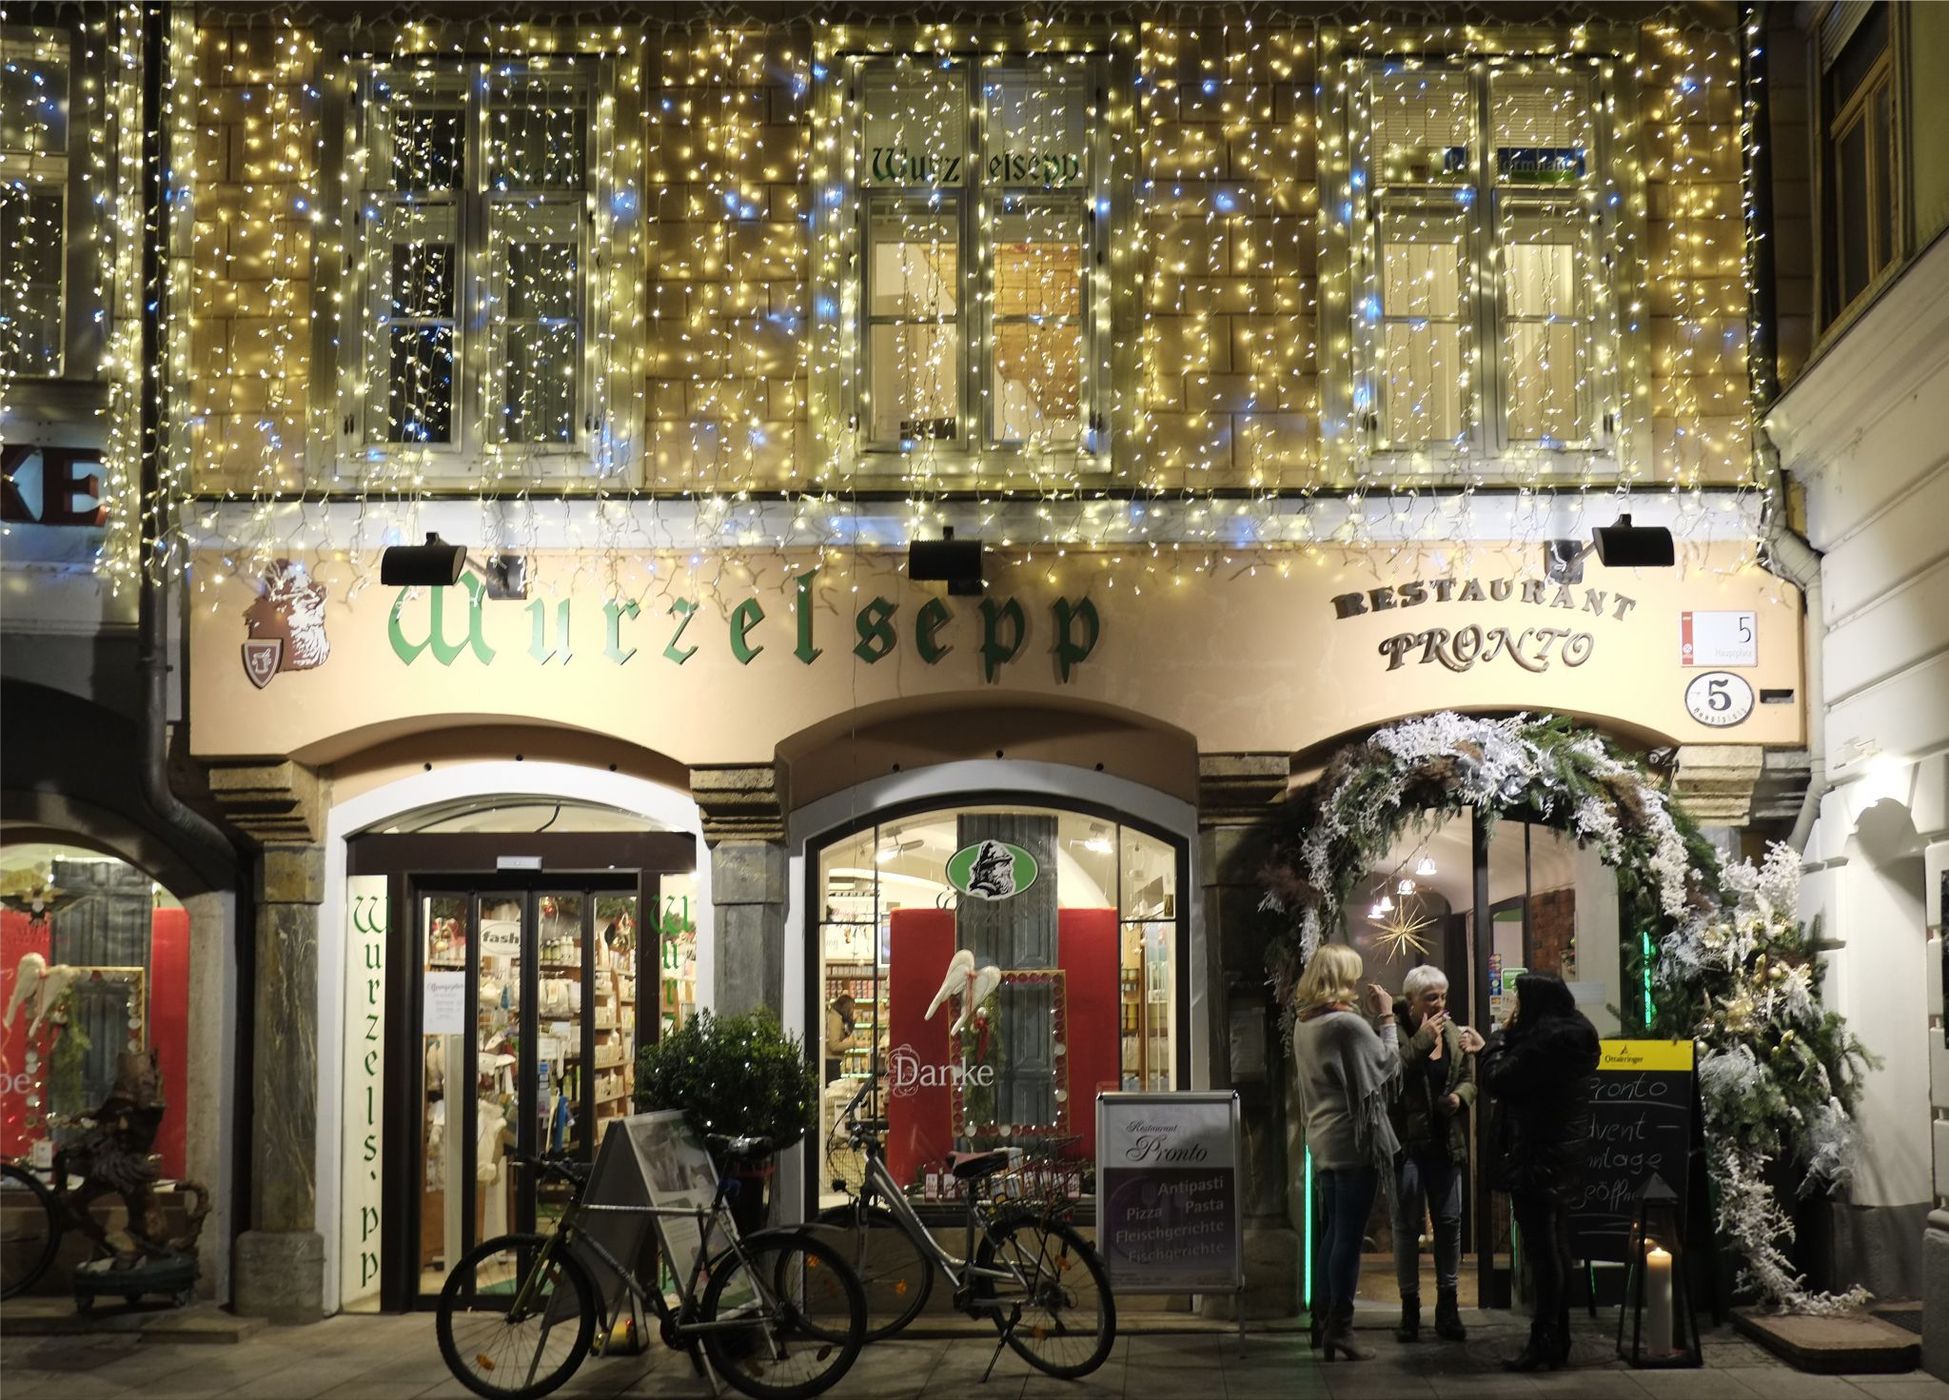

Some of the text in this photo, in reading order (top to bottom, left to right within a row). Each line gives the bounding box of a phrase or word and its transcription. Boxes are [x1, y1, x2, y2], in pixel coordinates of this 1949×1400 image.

[1331, 577, 1636, 621] RESTAURANT
[388, 570, 1099, 684] Wurzelsepp
[1738, 616, 1752, 643] 5
[1378, 623, 1594, 673] PRONTO
[1708, 679, 1732, 711] 5
[482, 931, 519, 943] fash
[893, 1055, 994, 1087] Danke
[1126, 1120, 1179, 1132] Restaurant
[1125, 1135, 1209, 1163] Pronto
[1157, 1176, 1224, 1196] Antipasti
[1126, 1198, 1224, 1221] Pizza Pasta
[1115, 1220, 1224, 1244] Fleischgerichte
[1128, 1241, 1224, 1263] Fischgerichte
